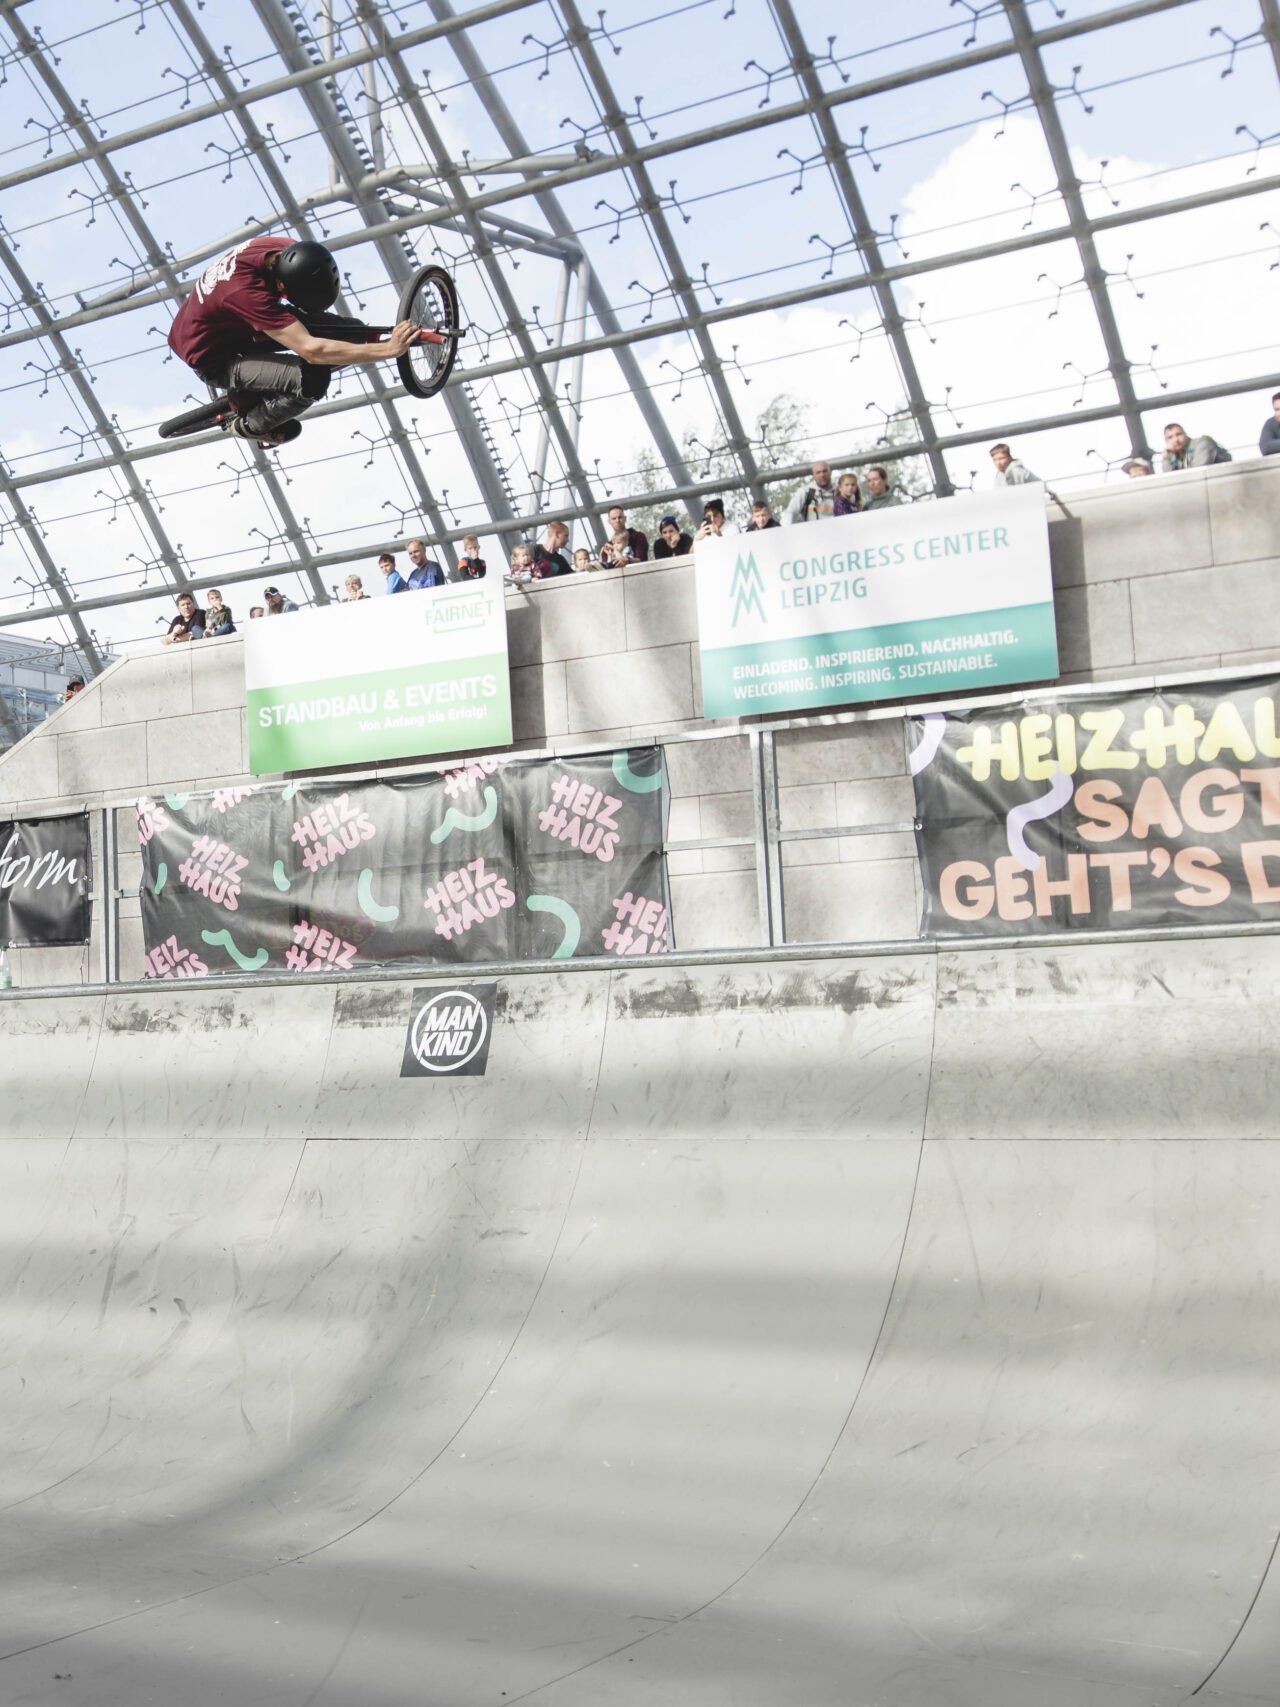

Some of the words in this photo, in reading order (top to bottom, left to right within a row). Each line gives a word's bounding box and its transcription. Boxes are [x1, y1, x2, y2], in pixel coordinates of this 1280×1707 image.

[779, 543, 906, 582] CONGRESS
[913, 527, 1010, 561] CENTER
[425, 600, 494, 625] FAIRNET
[781, 577, 868, 610] LEIPZIG
[733, 656, 813, 680] EINLADEND.
[815, 643, 919, 669] INSPIRIEREND.
[921, 629, 1019, 655] NACHHALTIG.
[733, 676, 818, 700] WELCOMING.
[821, 666, 896, 689] INSPIRING.
[899, 653, 998, 680] SUSTAINABLE.
[258, 693, 376, 728] STANDBAU
[383, 689, 400, 710] &
[406, 674, 497, 707] EVENTS
[359, 719, 381, 732] Von
[384, 714, 425, 730] Anfang
[428, 711, 445, 723] bis
[448, 704, 488, 721] Erfolg!
[291, 793, 360, 847] HEIZ
[551, 775, 623, 831] HEIZ
[192, 835, 249, 883] HEIZ
[303, 812, 376, 872] HAUS
[538, 804, 620, 862] HAUS
[178, 858, 241, 910] HAUS
[424, 857, 497, 913] HEIZ
[434, 878, 515, 940] HAUS
[939, 846, 1231, 921] GEHT'S
[293, 920, 358, 970] HEIZ
[424, 1000, 482, 1031] MAN
[417, 1031, 474, 1061] KIND
